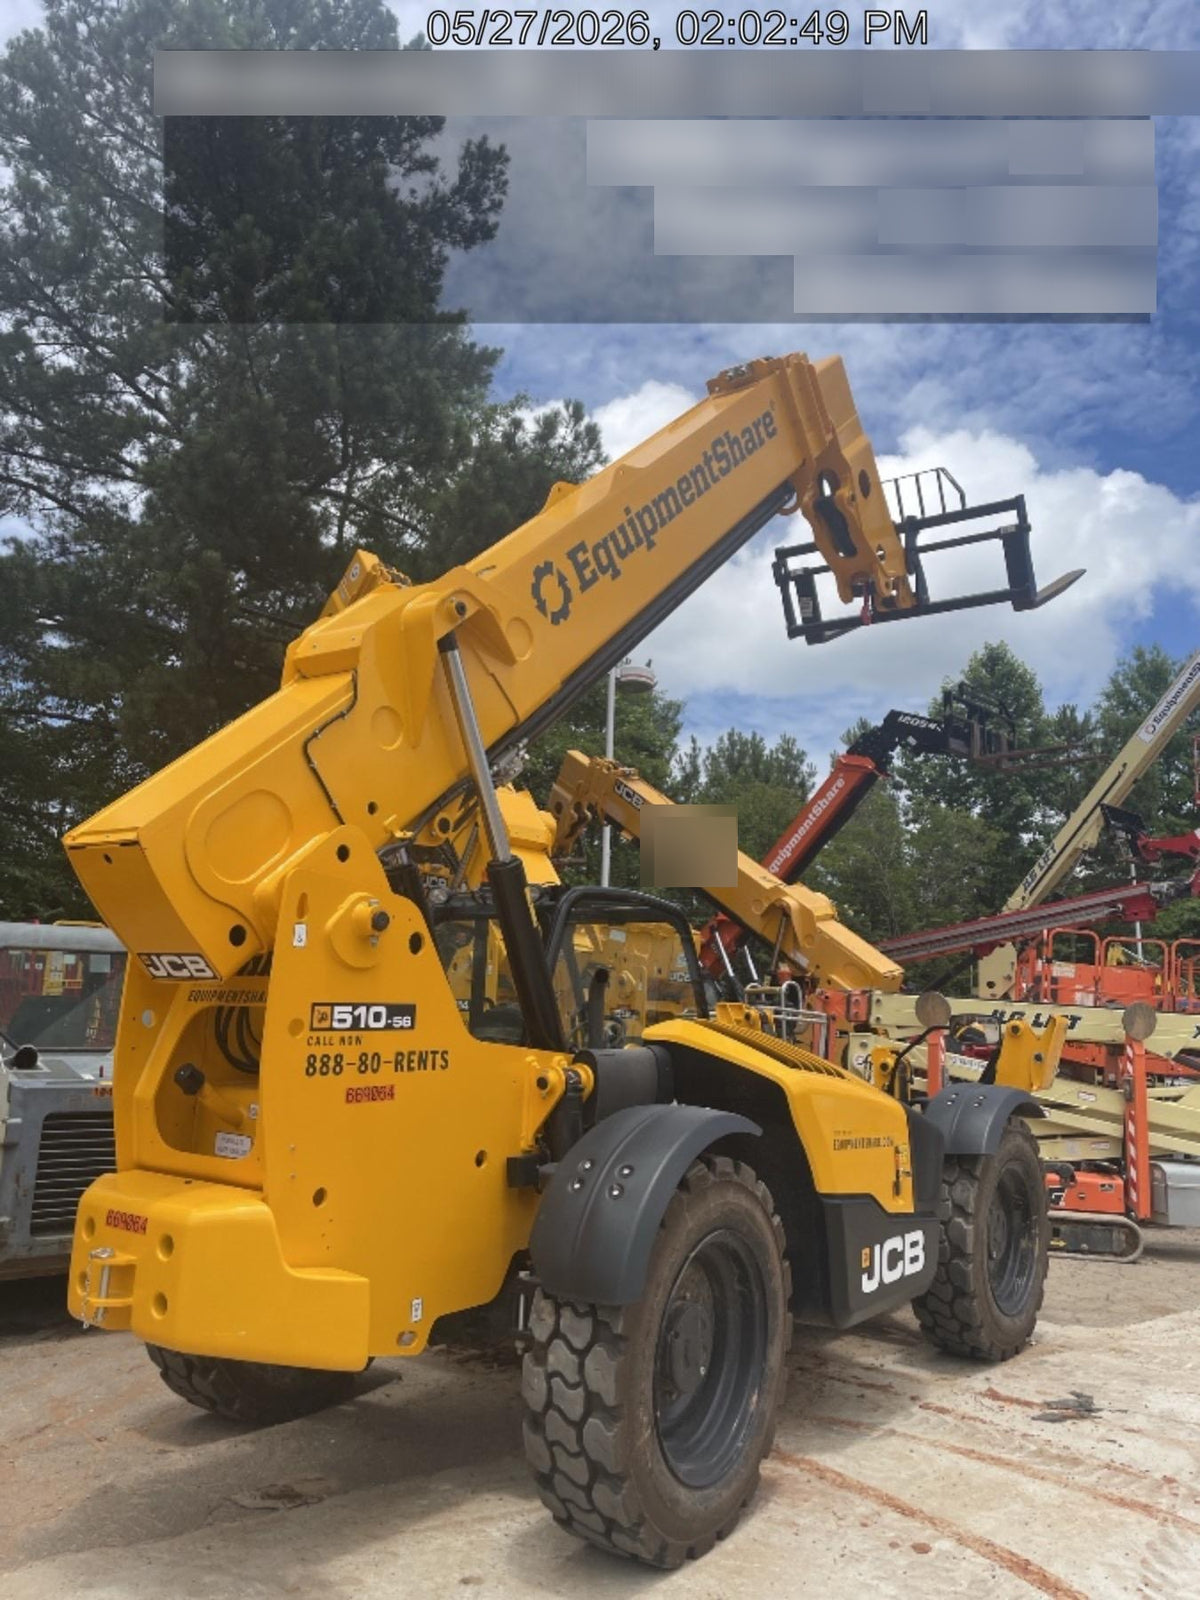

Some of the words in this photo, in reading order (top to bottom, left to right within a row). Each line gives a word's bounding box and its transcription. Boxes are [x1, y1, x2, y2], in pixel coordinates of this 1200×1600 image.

[565, 410, 779, 594] EquipmentShare
[614, 781, 644, 808] JCB
[769, 777, 846, 874] quipmentShare
[148, 954, 215, 978] JCB
[188, 989, 268, 1004] EQUIPMENTSHA
[306, 1035, 334, 1047] CALL
[338, 1034, 364, 1046] NOW
[305, 1050, 450, 1077] 888-80-RENTS
[861, 1229, 925, 1294] JCB
